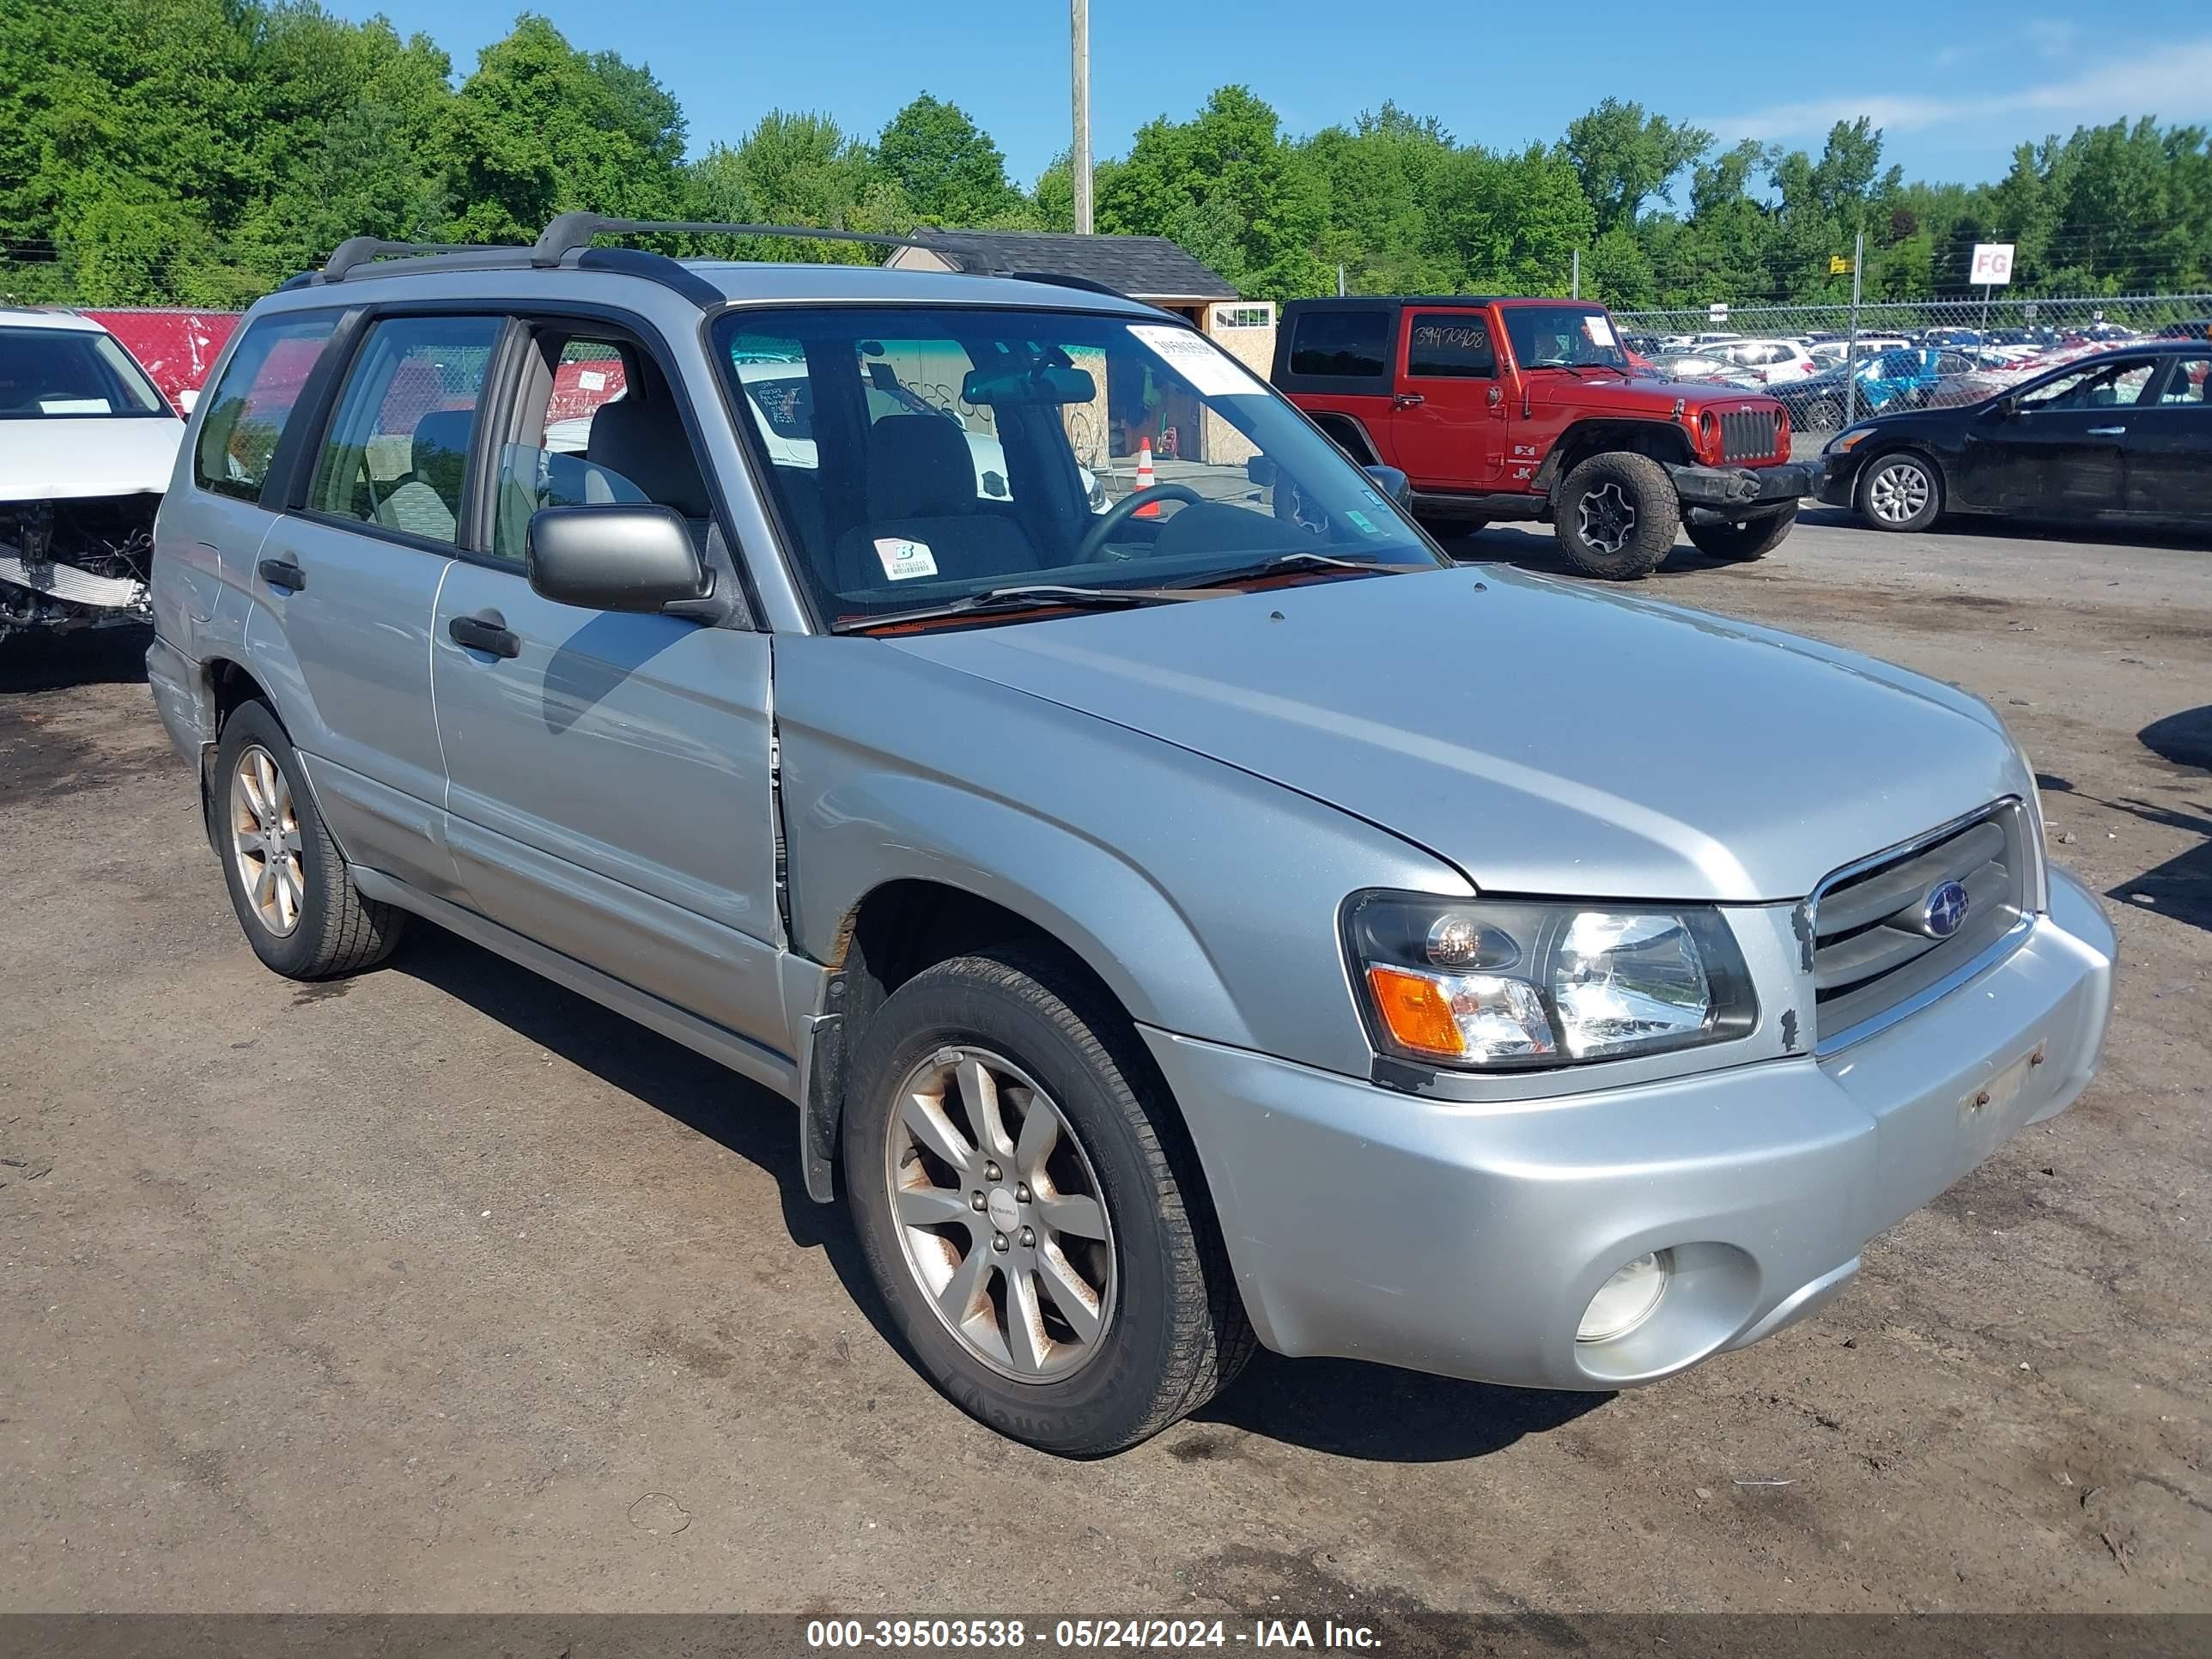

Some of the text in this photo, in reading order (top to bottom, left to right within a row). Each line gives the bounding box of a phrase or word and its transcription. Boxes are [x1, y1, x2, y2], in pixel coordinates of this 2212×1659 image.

[1977, 253, 2008, 274] FG
[1415, 326, 1485, 349] 39470408
[1512, 467, 1532, 480] JK
